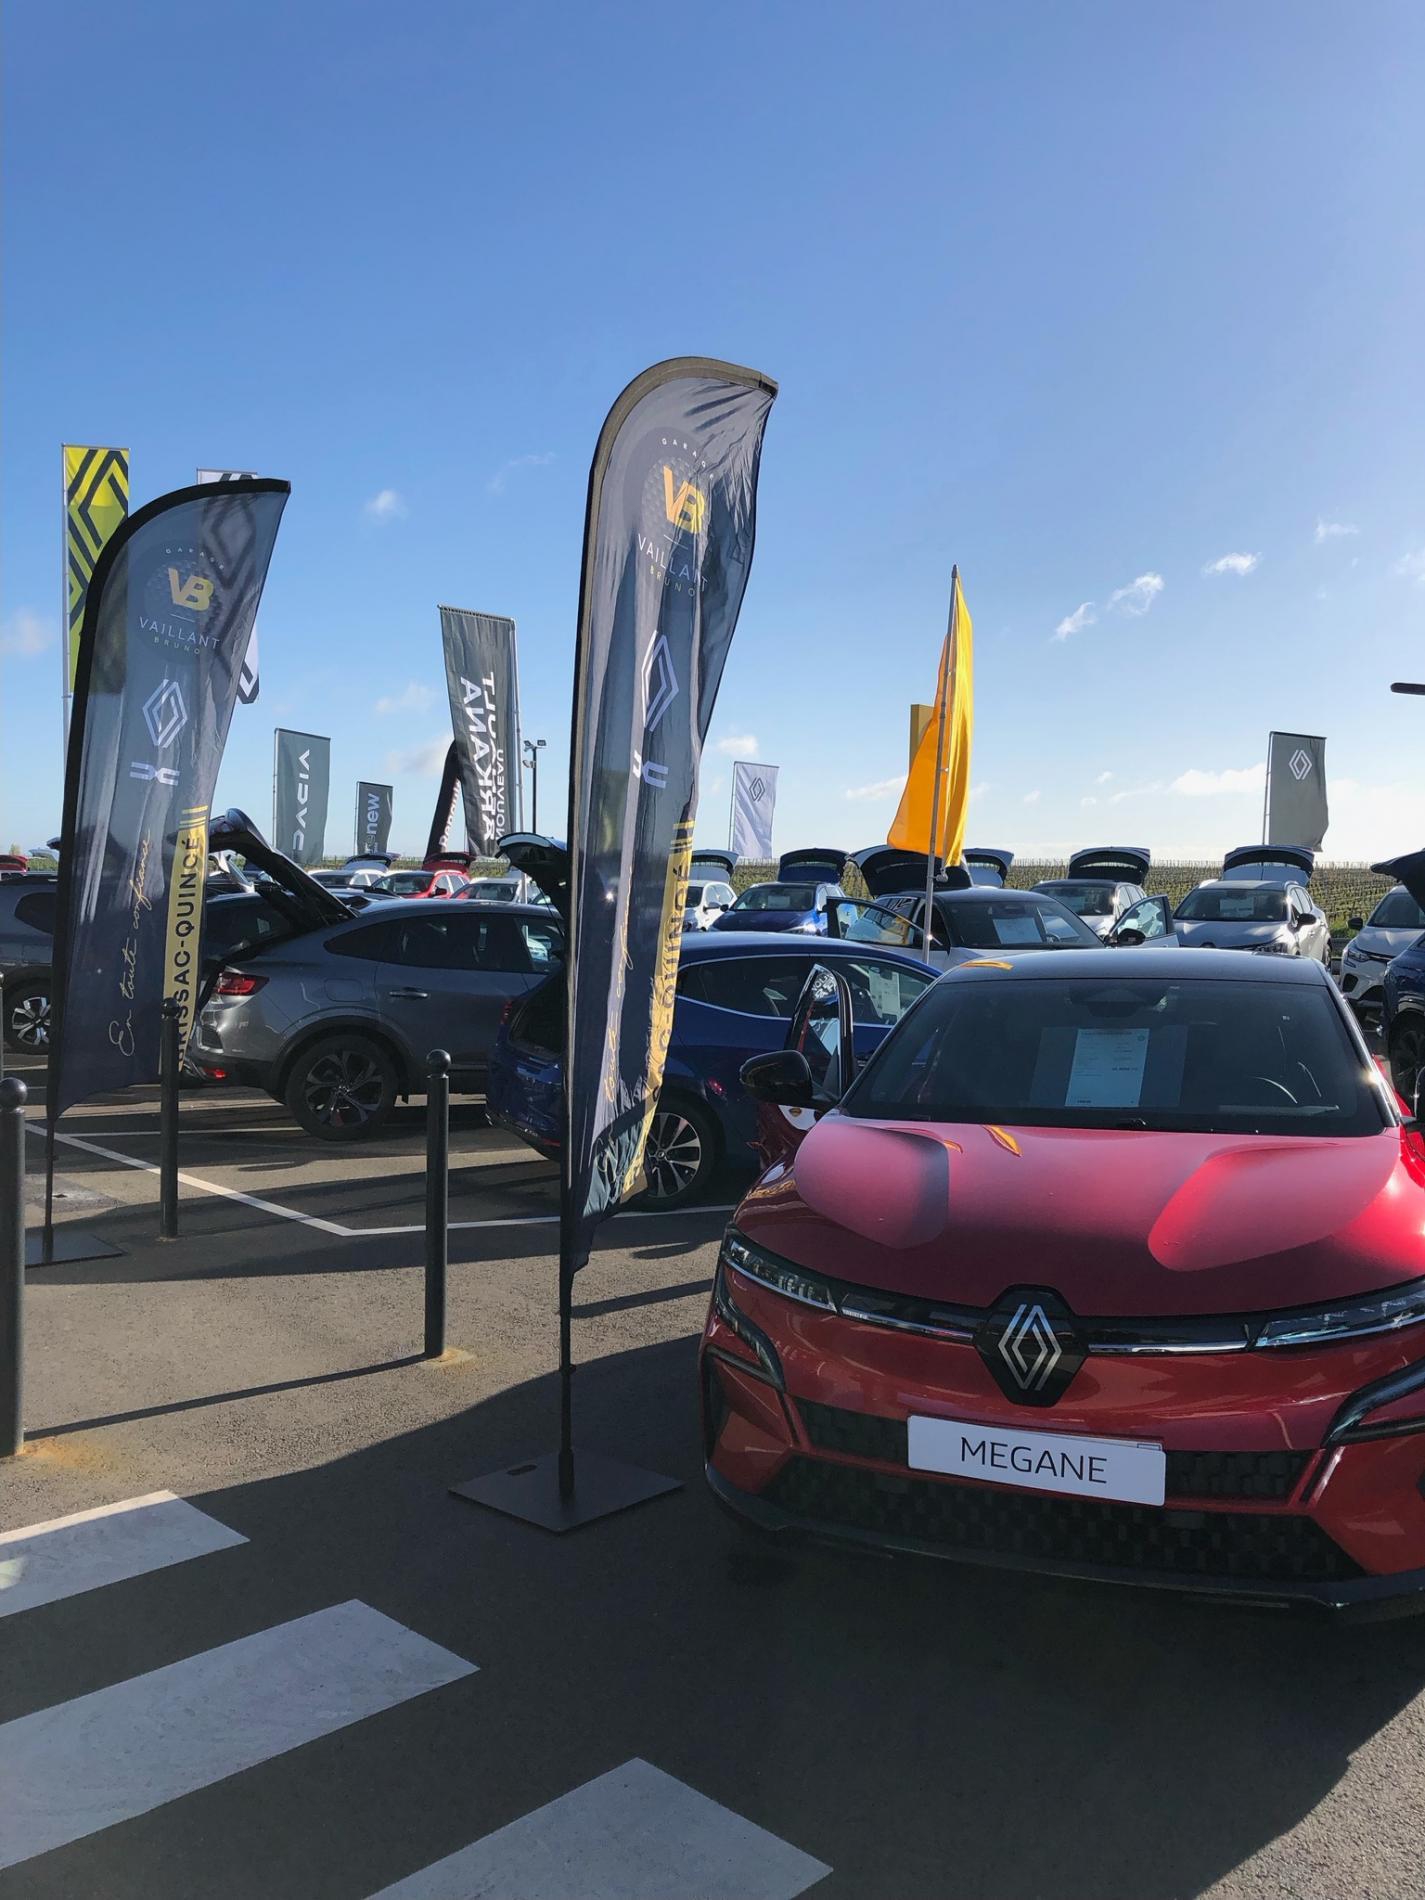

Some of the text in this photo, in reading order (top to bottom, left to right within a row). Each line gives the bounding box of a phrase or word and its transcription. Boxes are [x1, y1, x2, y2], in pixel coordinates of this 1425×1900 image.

[168, 568, 214, 611] VB
[139, 616, 220, 648] VAILLANT
[154, 636, 200, 655] BRUNO
[108, 830, 152, 1057] En toute confiance
[961, 1436, 1107, 1484] MEGANE
